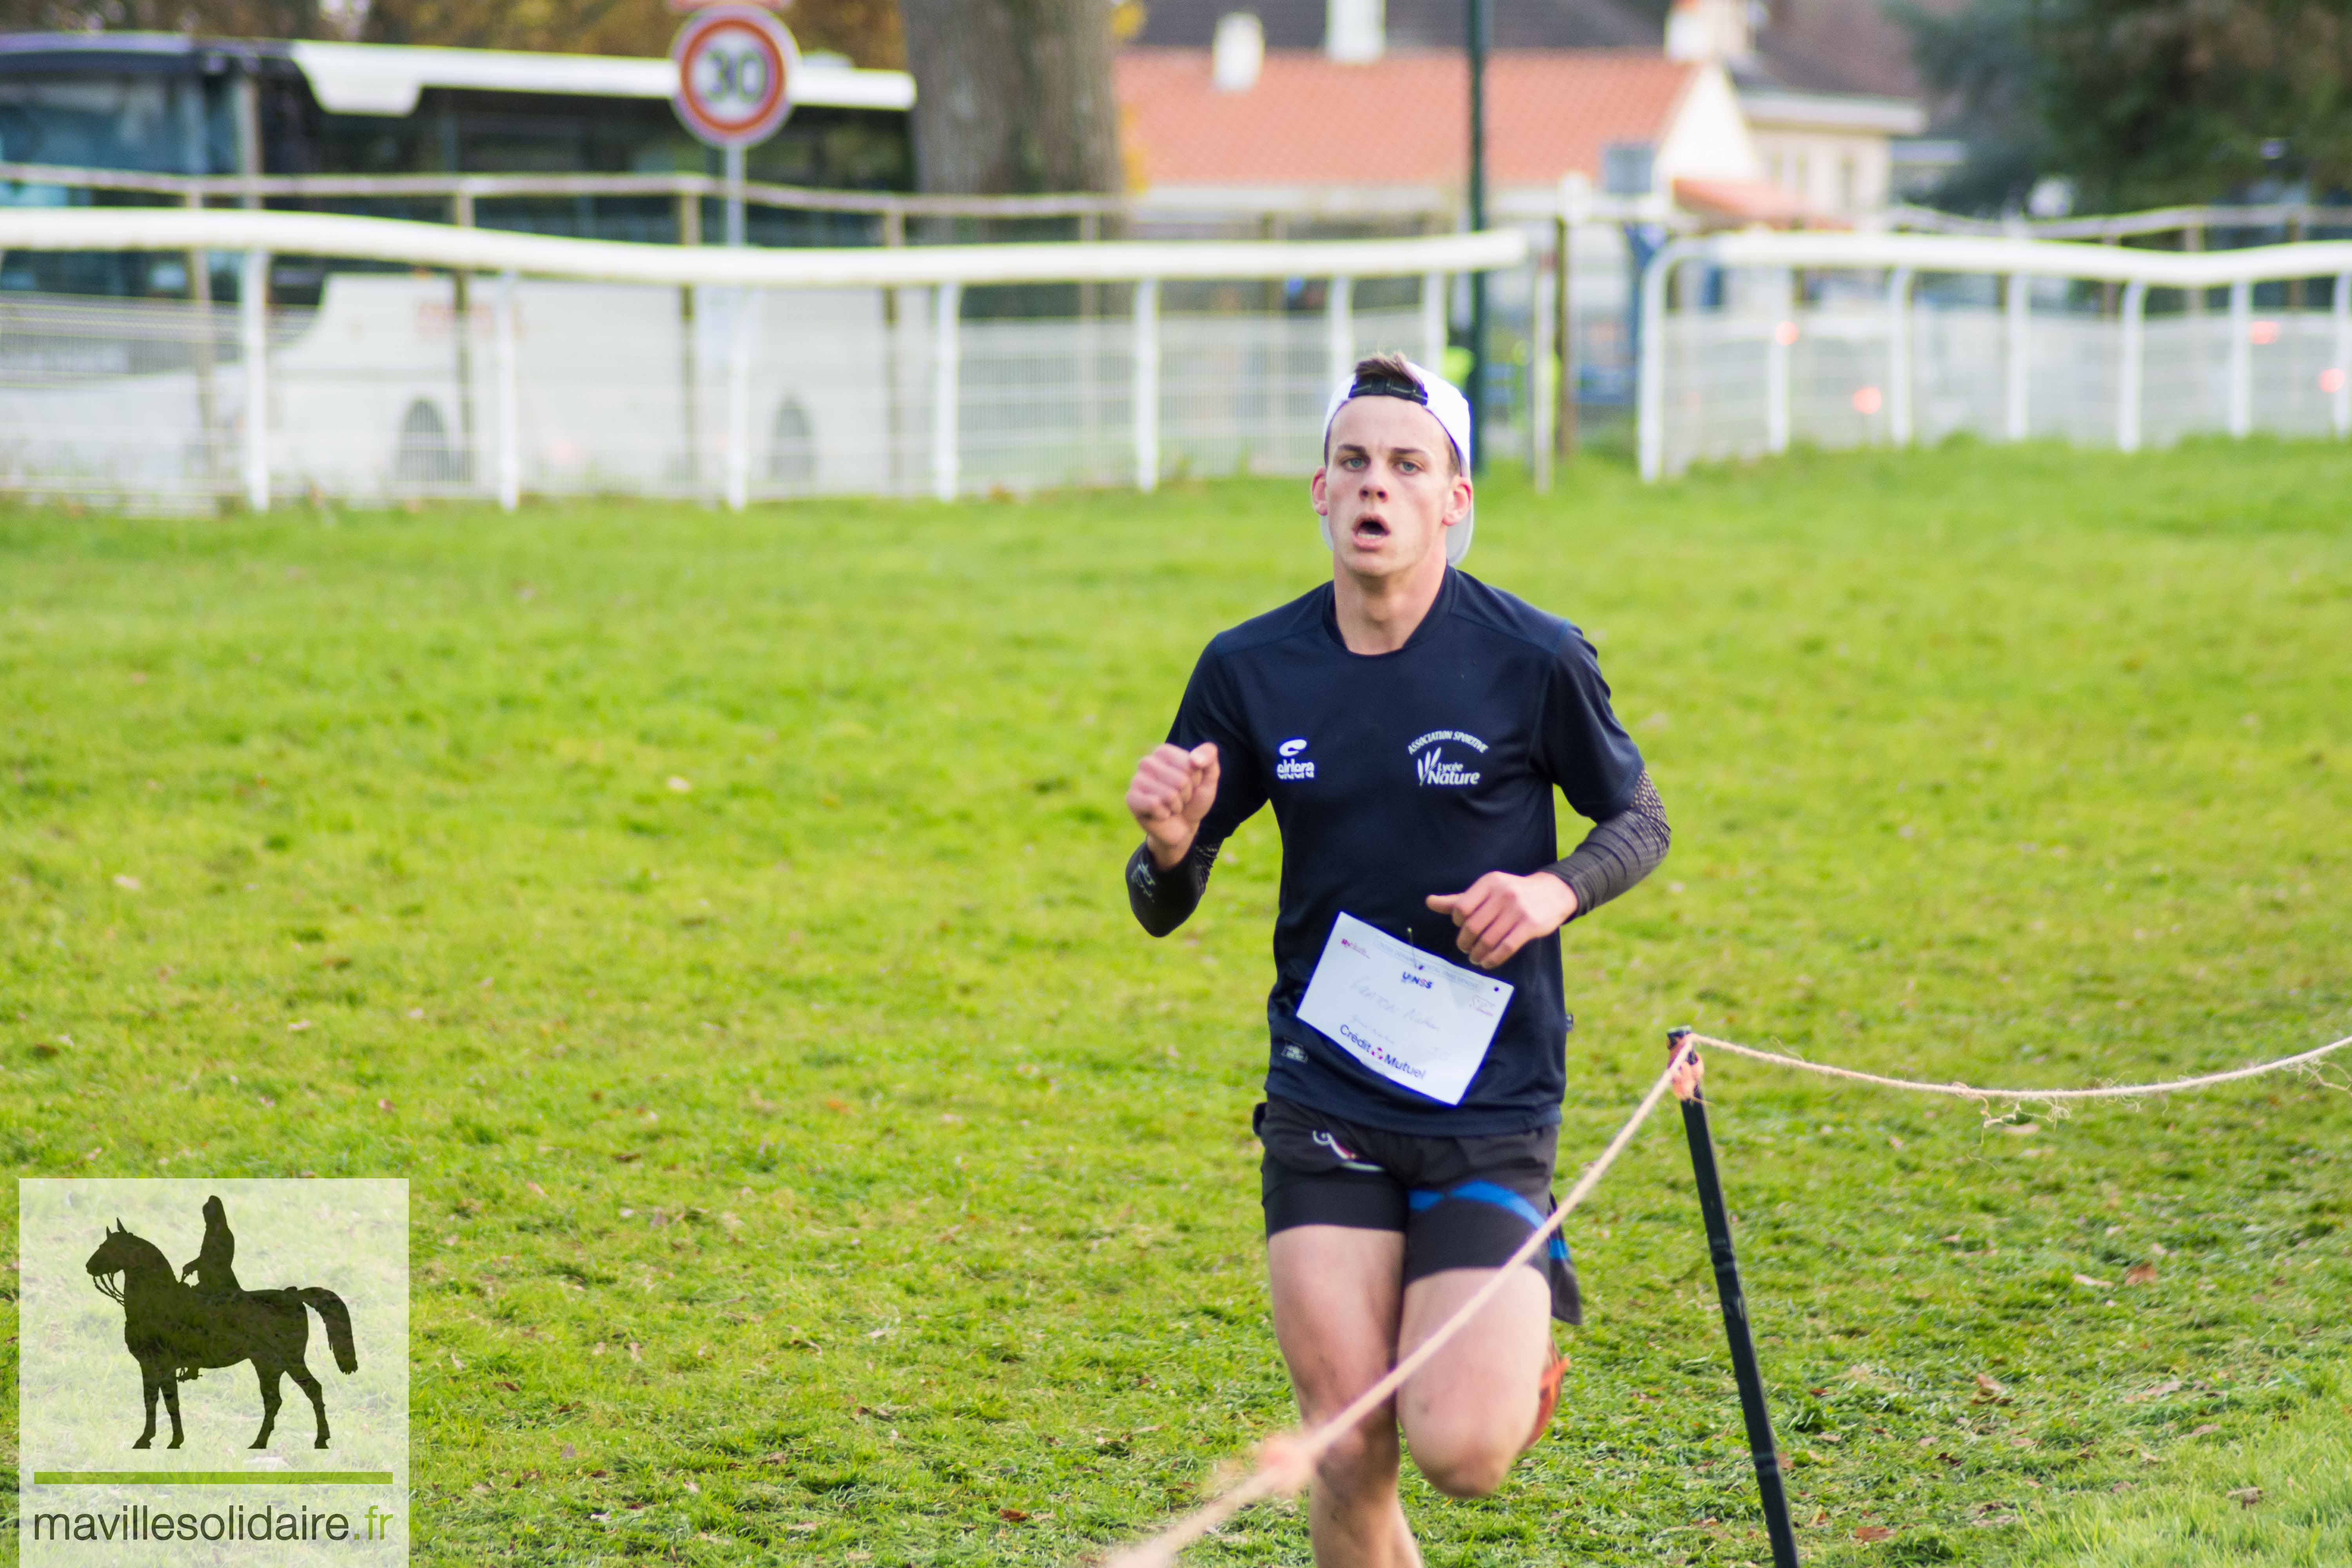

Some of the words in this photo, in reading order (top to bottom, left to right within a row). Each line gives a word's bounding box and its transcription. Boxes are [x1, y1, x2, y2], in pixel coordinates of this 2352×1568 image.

[704, 50, 766, 103] 30
[1407, 730, 1453, 755] ASSOCIATION
[1453, 731, 1490, 754] SPORTIVE
[1427, 770, 1480, 784] Nature
[1438, 762, 1464, 773] Lycée
[1340, 1024, 1371, 1053] Crédit
[1384, 1054, 1427, 1080] Mutuel
